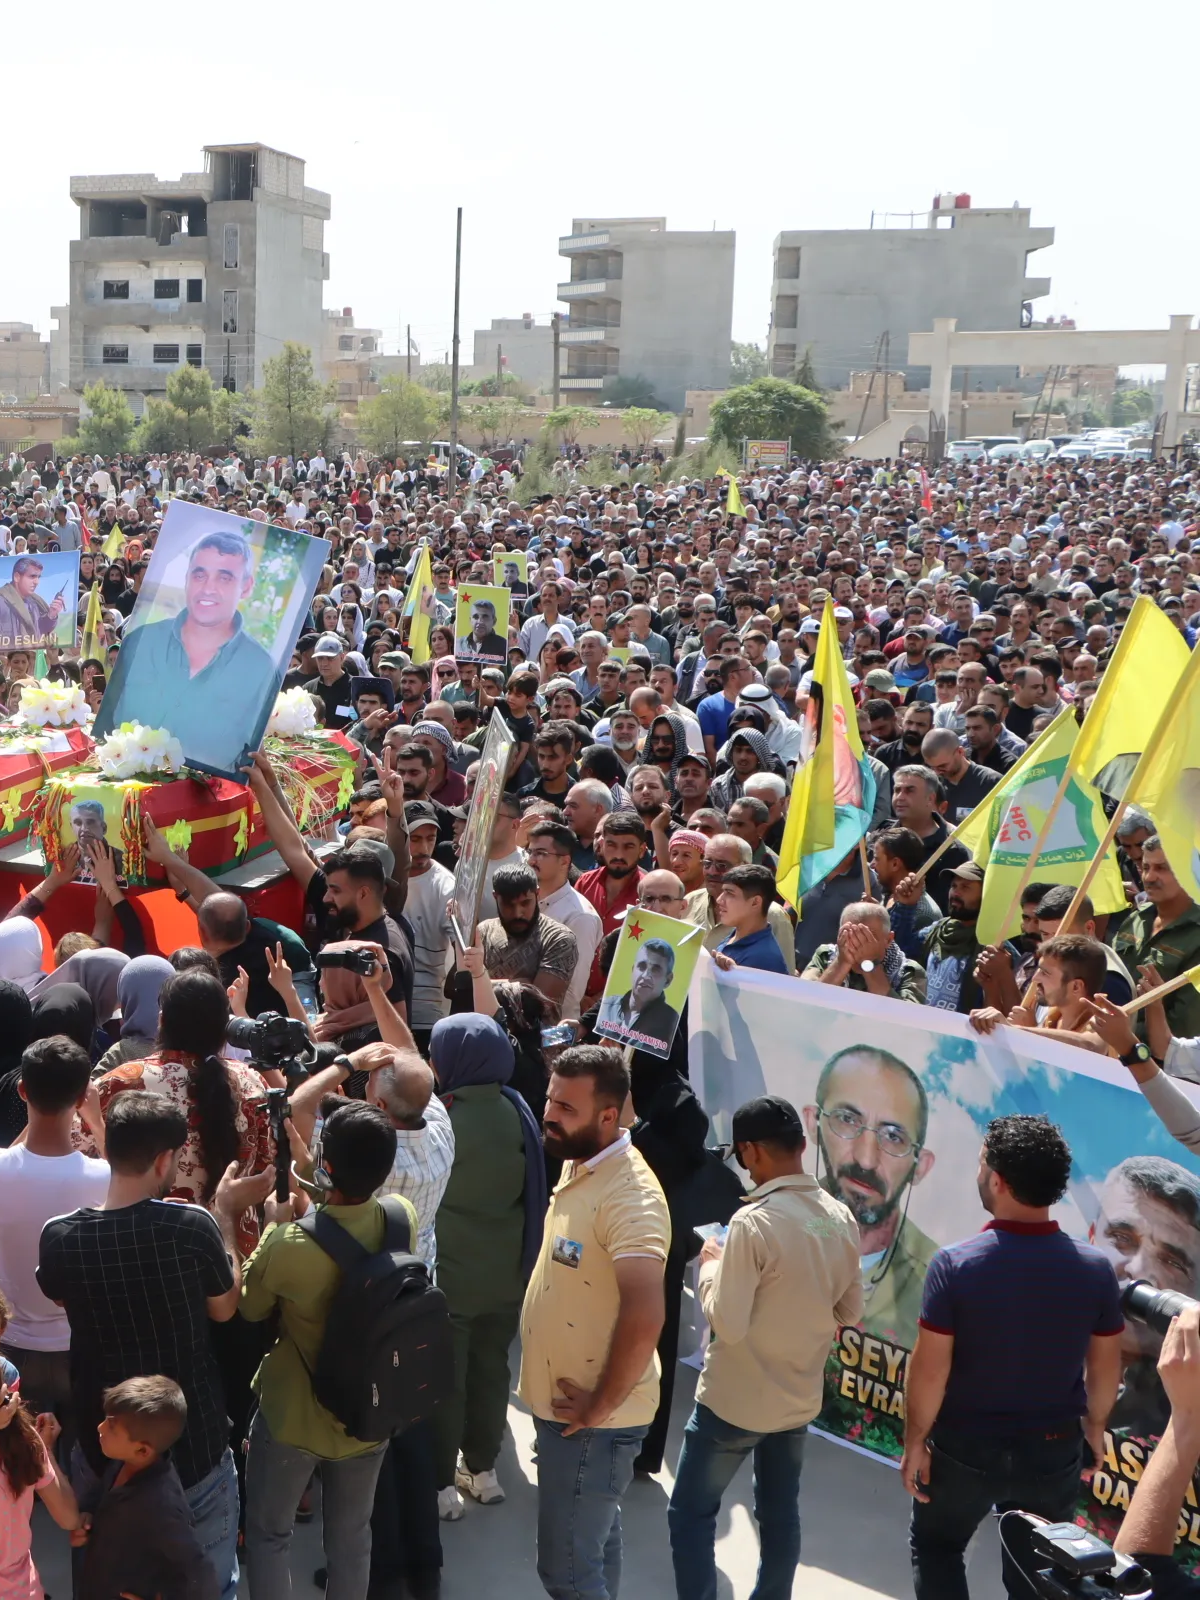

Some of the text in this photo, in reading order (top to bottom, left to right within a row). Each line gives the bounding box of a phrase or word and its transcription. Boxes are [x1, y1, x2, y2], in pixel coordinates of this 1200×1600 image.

[1009, 806, 1032, 841] HPC
[638, 1033, 668, 1050] QAMIŞLO
[840, 1329, 911, 1386] SEYI
[841, 1370, 904, 1420] EVRA
